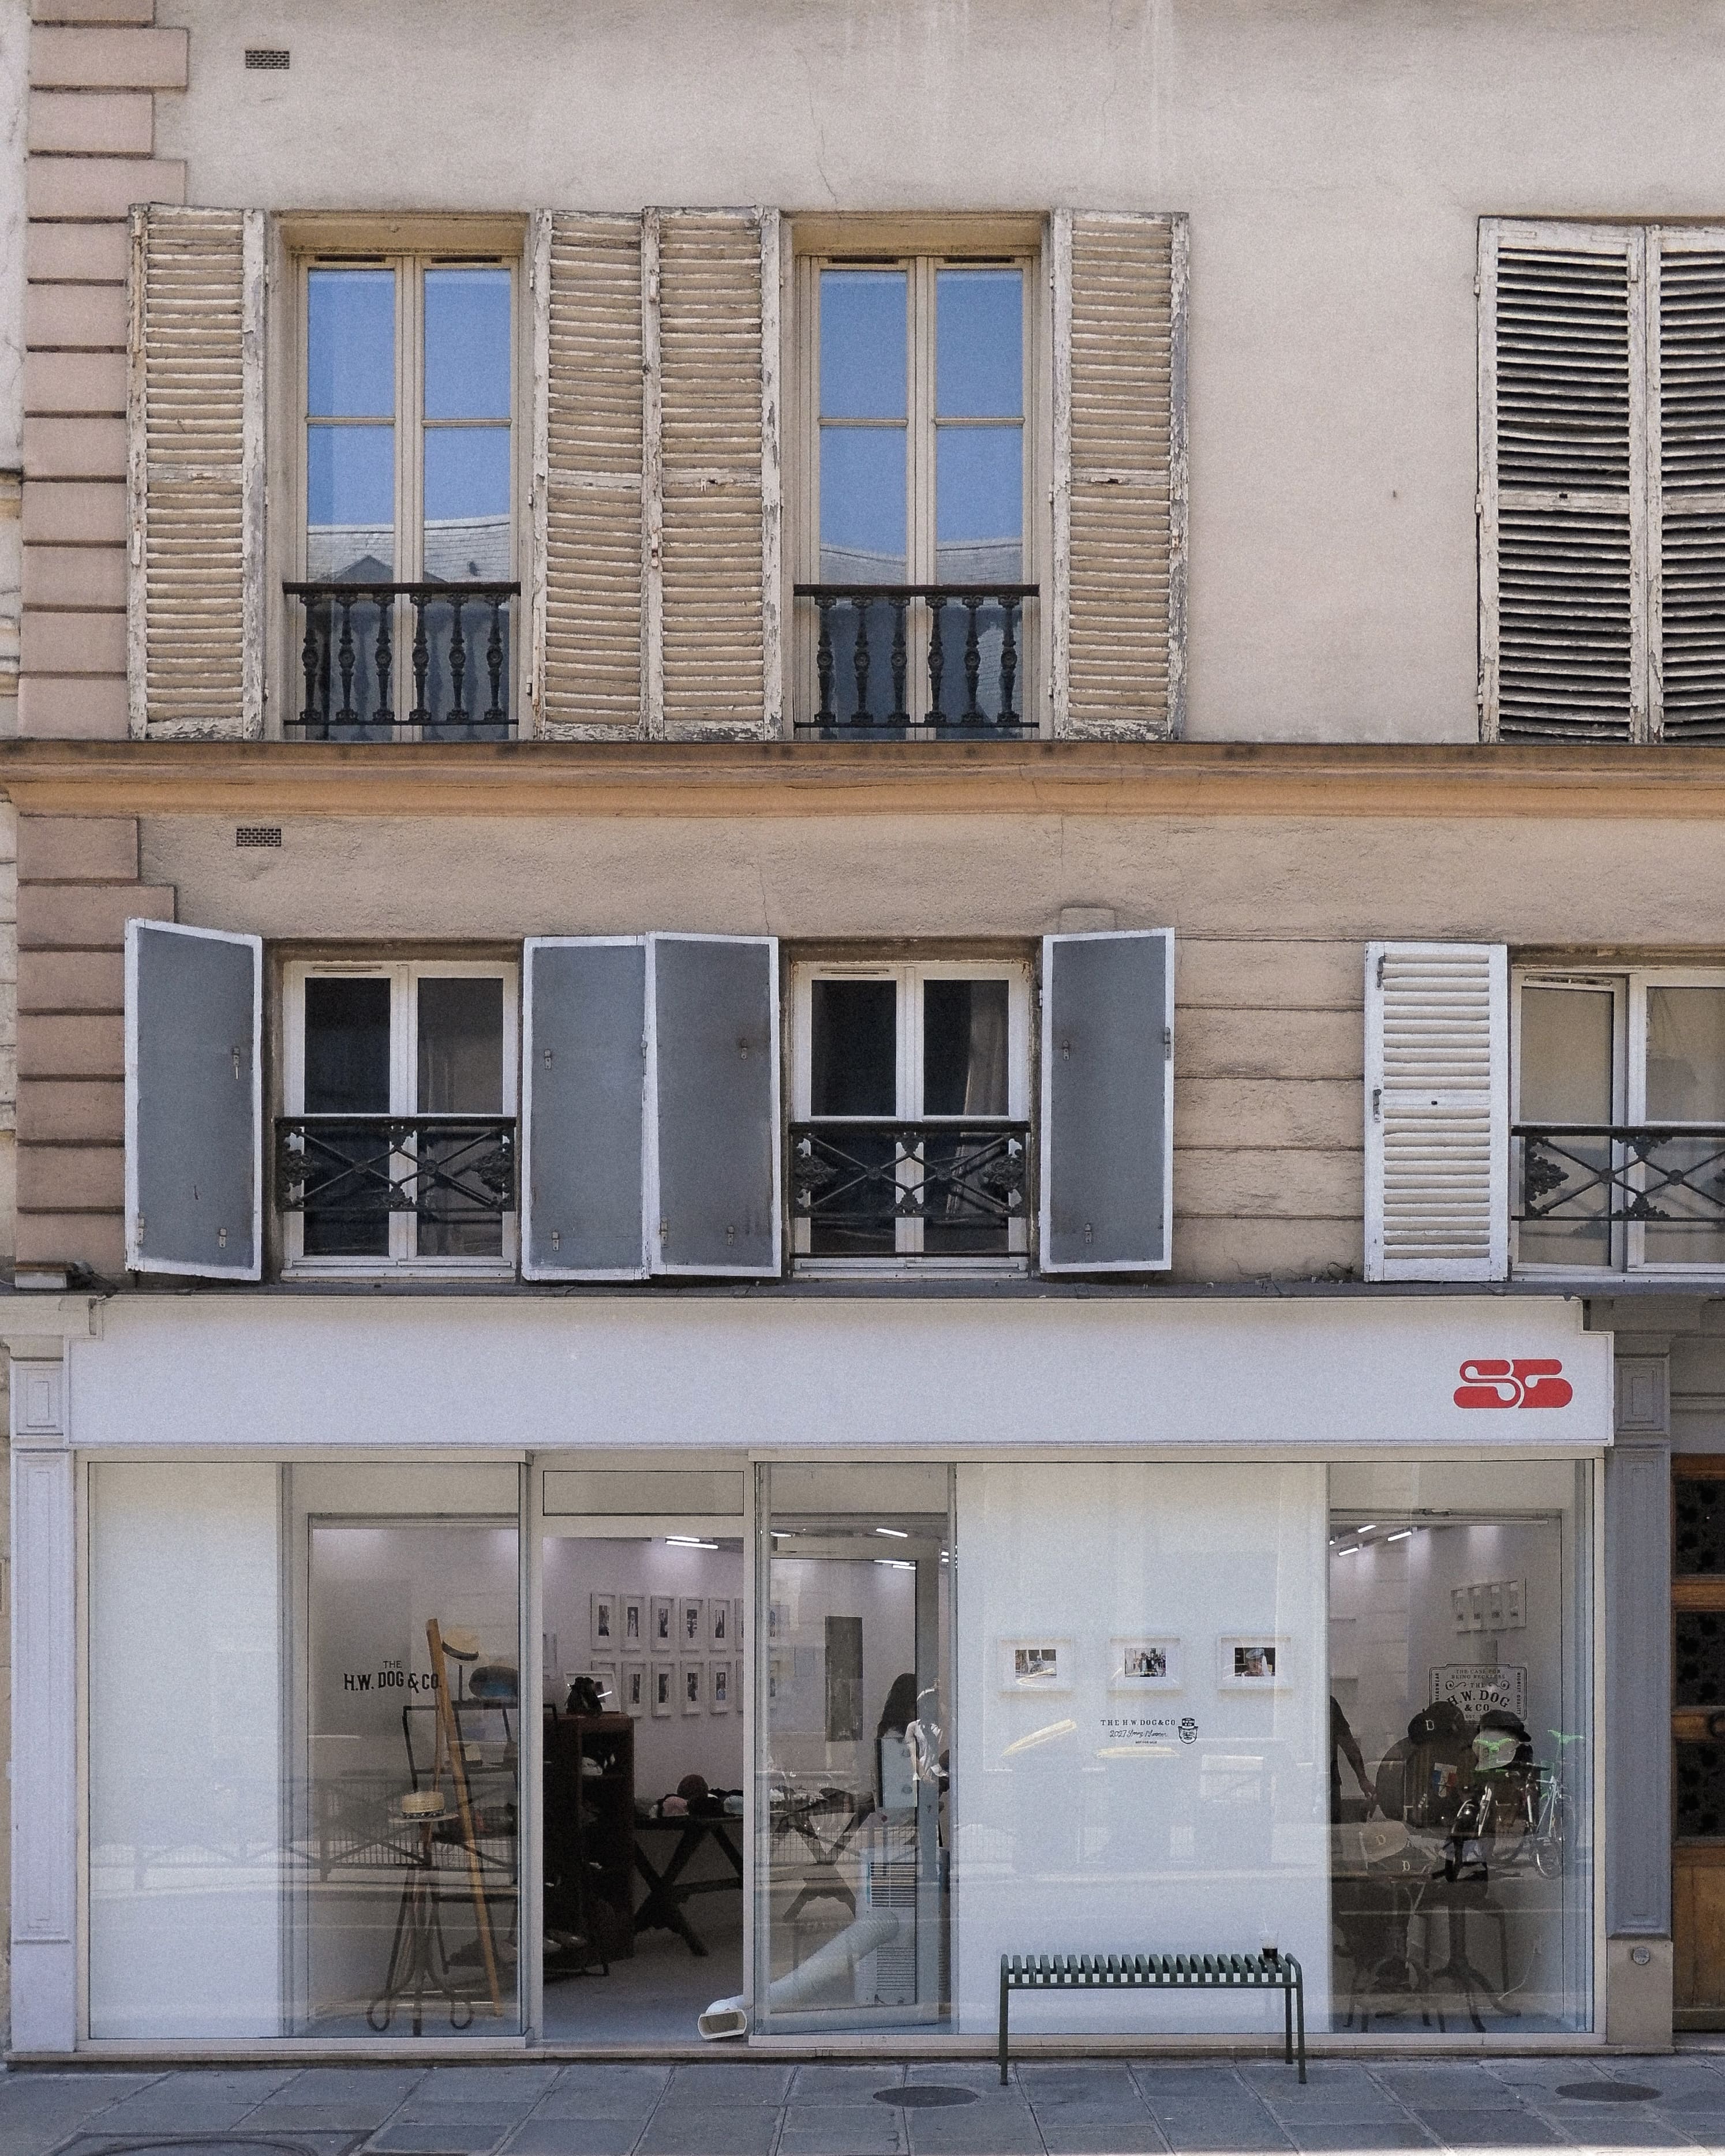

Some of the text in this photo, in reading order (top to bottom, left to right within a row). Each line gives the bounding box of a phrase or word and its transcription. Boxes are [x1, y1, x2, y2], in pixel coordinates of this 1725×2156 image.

[383, 1660, 402, 1668] THE
[343, 1673, 375, 1691] H.W.
[378, 1671, 405, 1689] DOG
[1446, 1690, 1510, 1708] H.W. DOG
[1464, 1704, 1490, 1712] & CO
[1425, 1720, 1435, 1731] D
[1109, 1730, 1127, 1738] 2027
[1375, 1834, 1386, 1846] D
[1402, 1860, 1410, 1871] D
